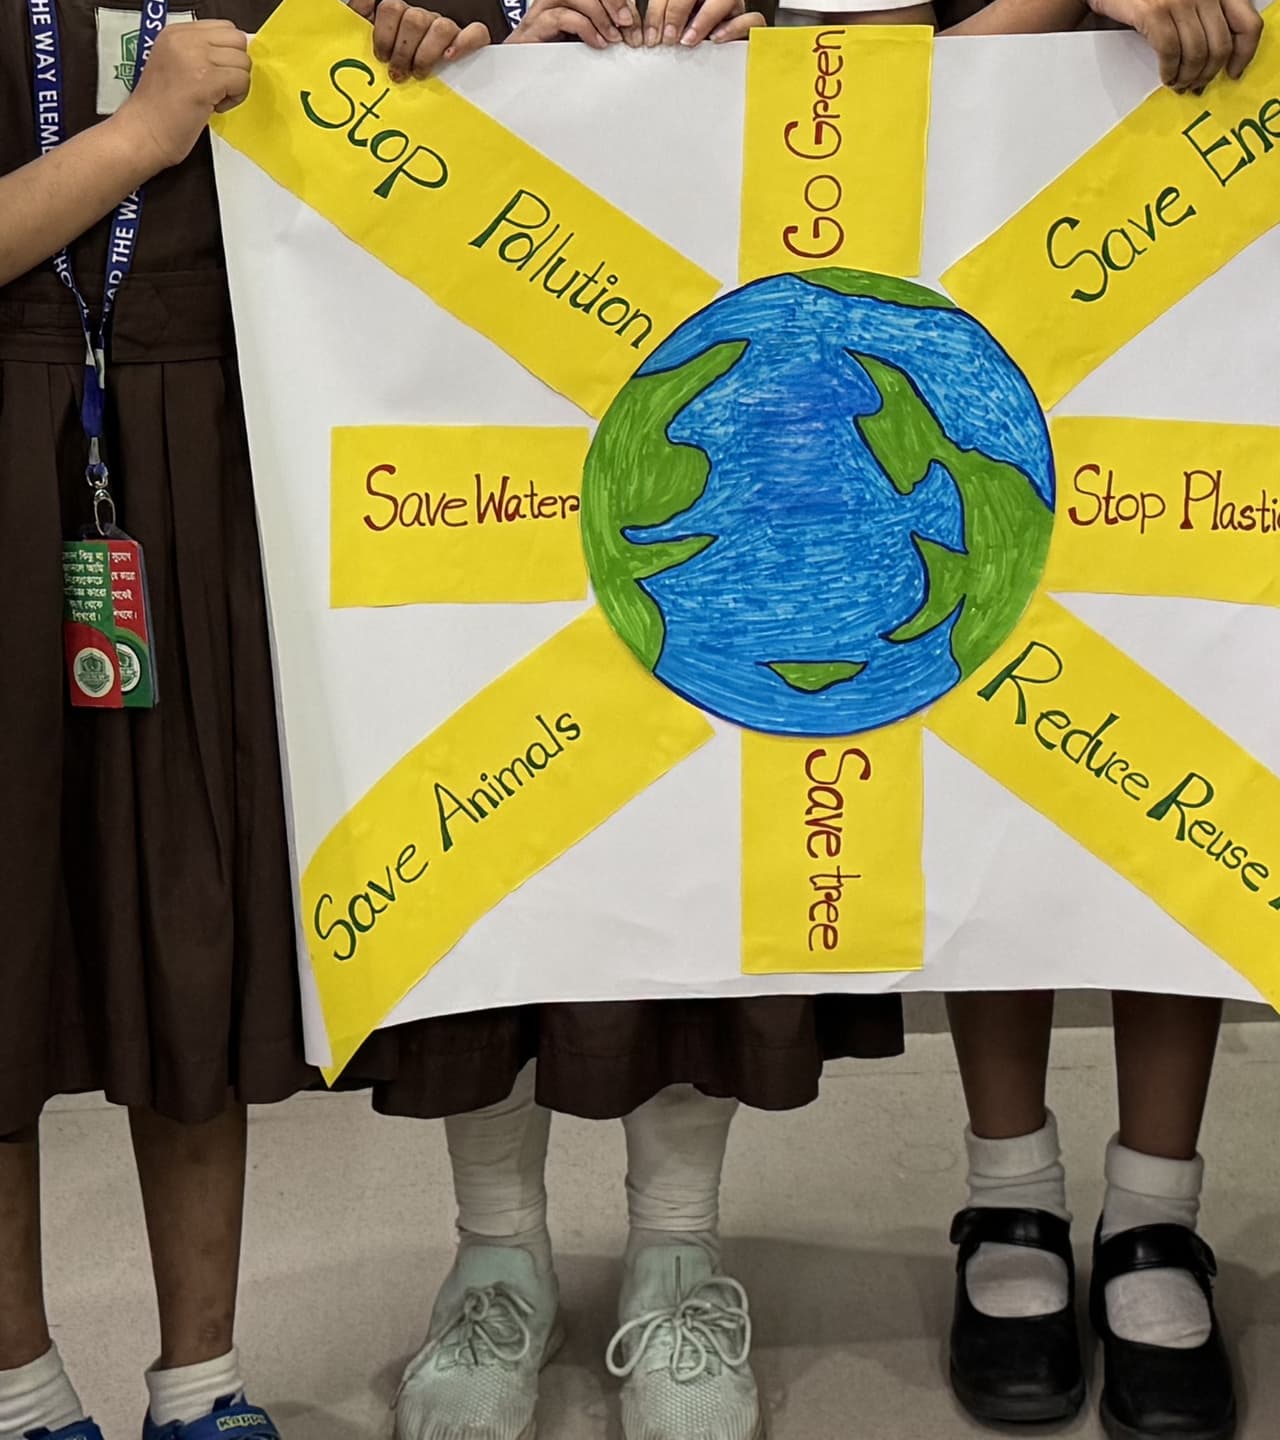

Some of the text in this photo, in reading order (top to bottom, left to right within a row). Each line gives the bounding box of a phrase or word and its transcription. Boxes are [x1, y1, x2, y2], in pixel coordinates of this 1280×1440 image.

[34, 31, 57, 83] WAY
[300, 58, 654, 349] Stop Pollution
[782, 29, 847, 259] Go Green
[112, 227, 135, 263] THE
[1046, 185, 1197, 302] Save
[363, 464, 580, 530] Save Water
[1068, 464, 1166, 534] Stop
[314, 712, 582, 961] Save Animals
[978, 641, 1150, 801] Reduce
[1147, 772, 1270, 892] Reuse
[805, 748, 871, 952] Save tree
